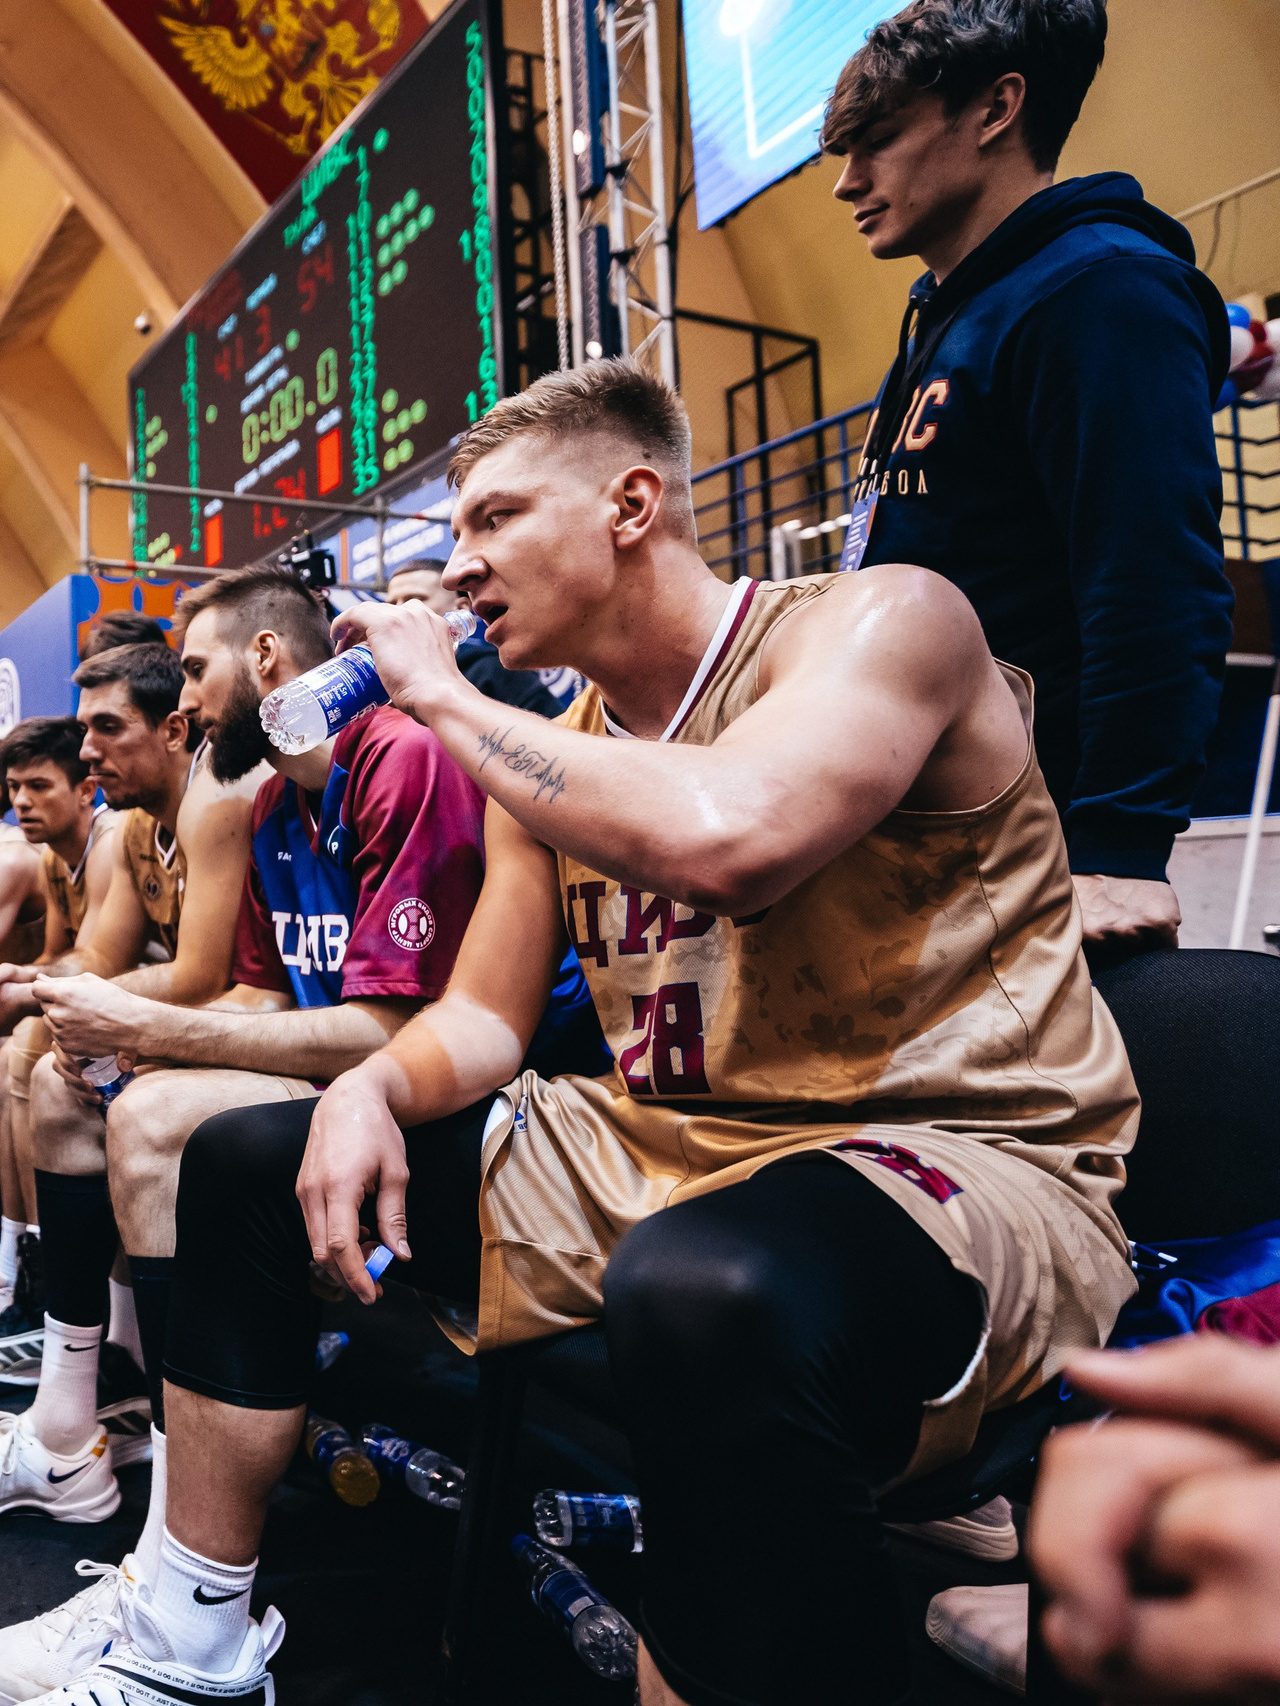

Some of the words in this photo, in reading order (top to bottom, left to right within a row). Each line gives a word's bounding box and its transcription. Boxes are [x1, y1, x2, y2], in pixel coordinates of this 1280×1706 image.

[241, 347, 338, 464] 0:00.0
[390, 900, 417, 928] ИГРОВЫХ
[417, 902, 433, 925] ВИДОВ
[392, 930, 413, 948] ЦЕНТР
[415, 927, 433, 948] СПОРТА
[619, 982, 712, 1095] 28
